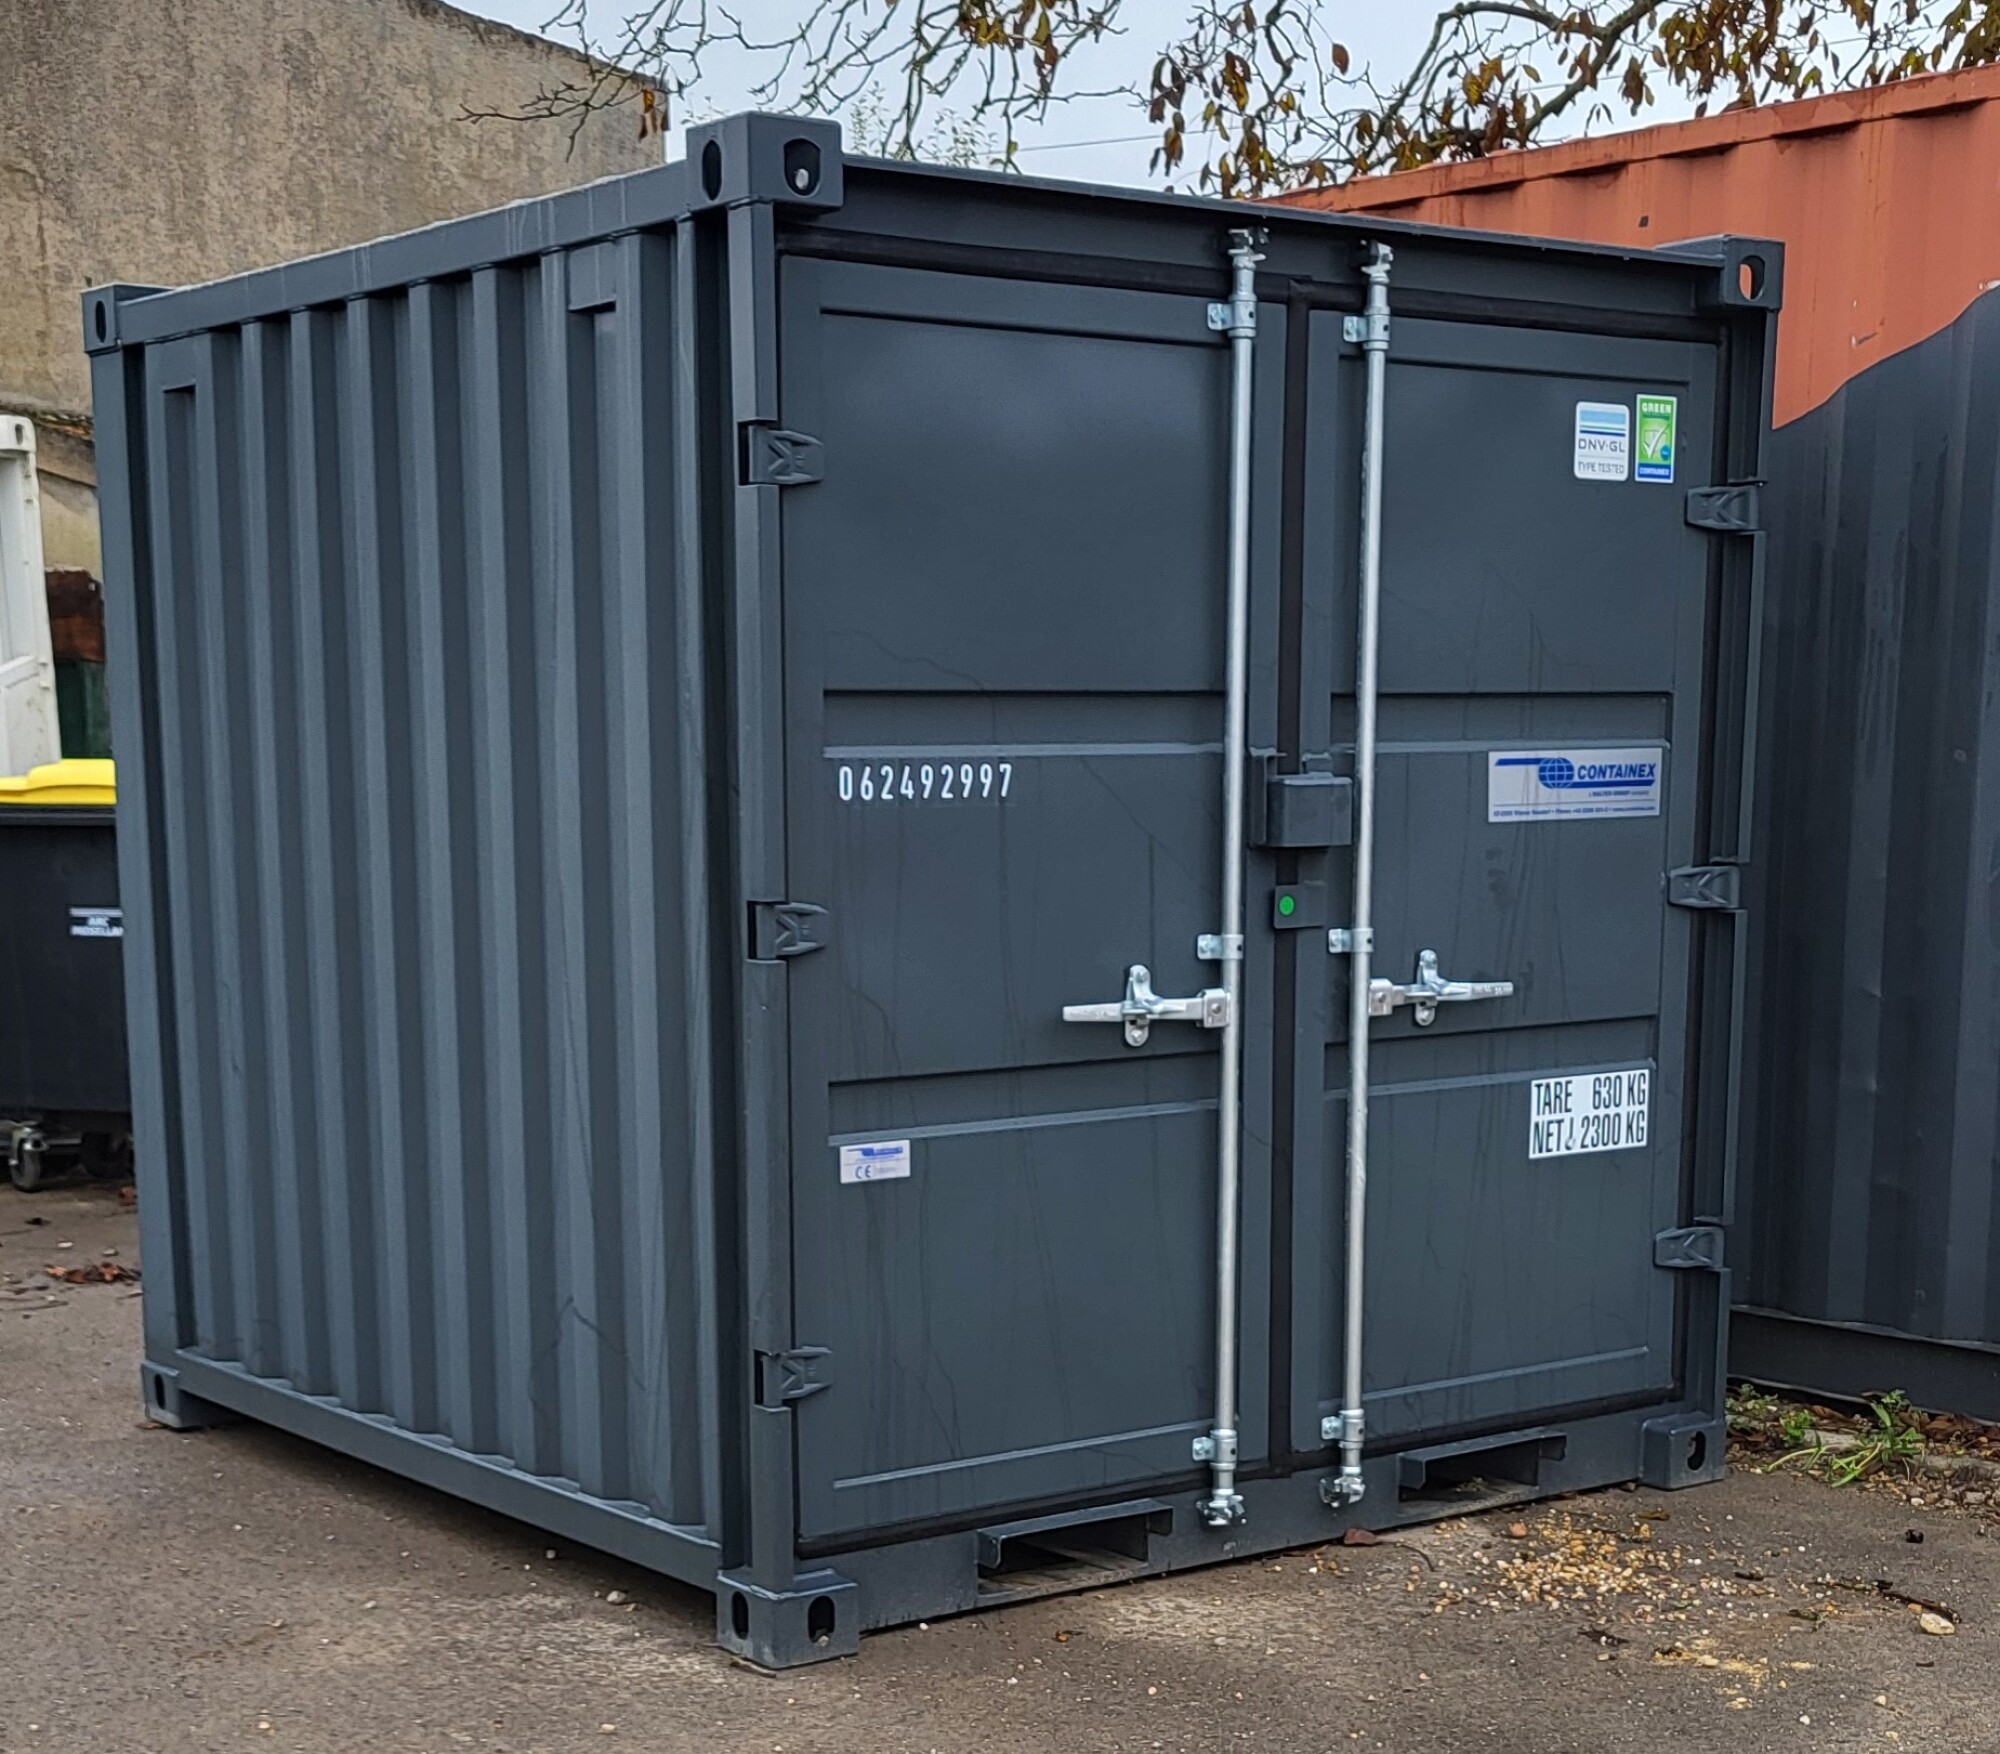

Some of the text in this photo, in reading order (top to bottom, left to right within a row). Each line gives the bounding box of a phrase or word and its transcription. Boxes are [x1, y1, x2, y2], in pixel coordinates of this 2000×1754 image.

[1641, 402, 1672, 414] GREEN
[1578, 461, 1625, 475] TYPE TESTED
[839, 763, 1012, 801] 062492997
[1577, 763, 1657, 780] CONTAINEX
[1533, 1072, 1646, 1116] TARE 630 KG
[1580, 1112, 1622, 1150] 2300
[1625, 1110, 1646, 1144] KG
